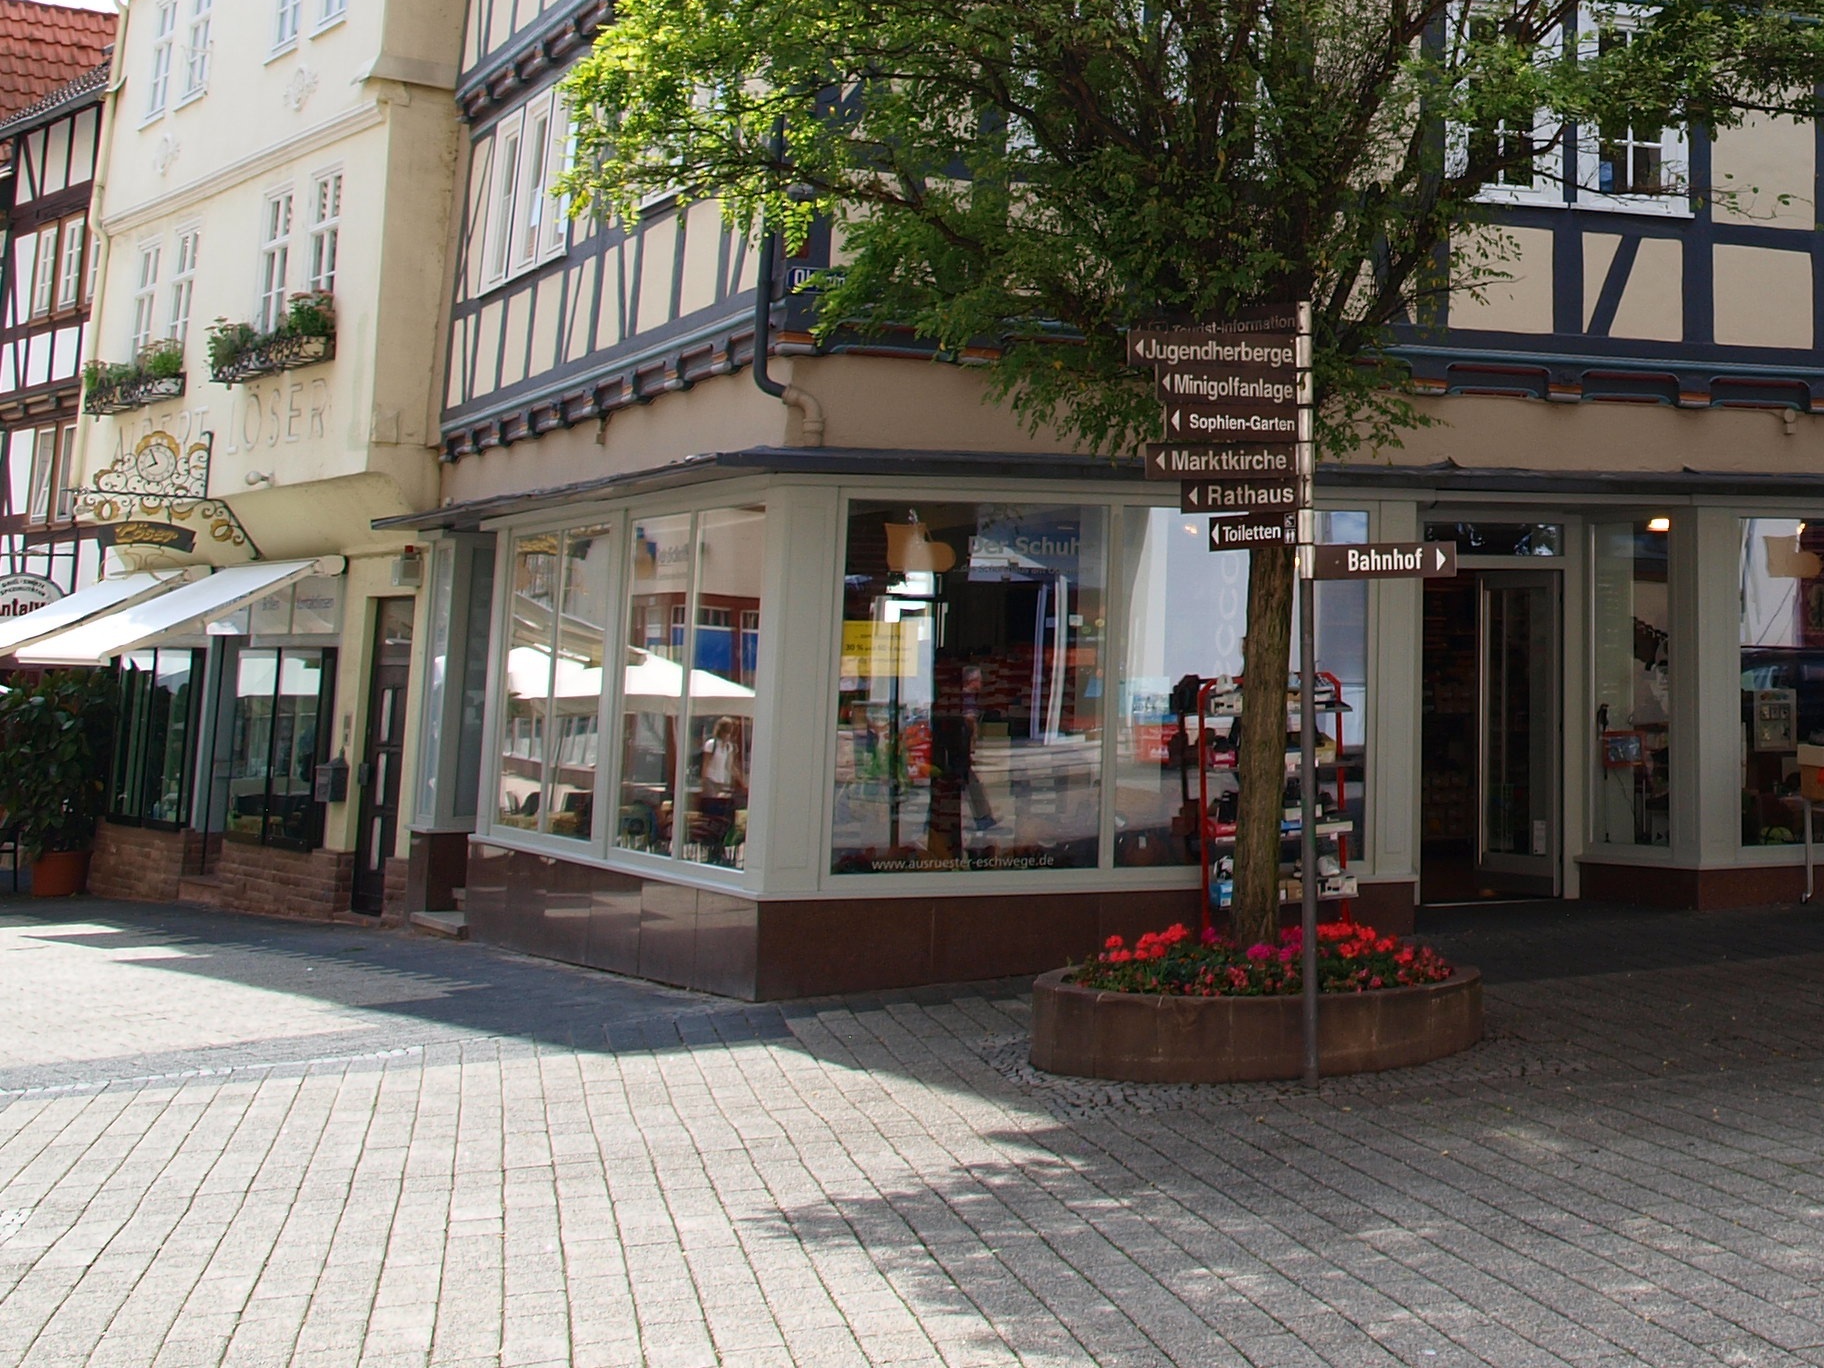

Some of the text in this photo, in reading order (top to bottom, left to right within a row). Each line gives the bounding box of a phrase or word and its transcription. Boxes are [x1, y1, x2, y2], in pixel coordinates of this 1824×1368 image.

[1145, 338, 1293, 367] Jugendherberge
[1174, 373, 1294, 404] Minigolfanlage
[225, 377, 329, 455] LÖSER
[1189, 413, 1295, 433] Sophien-Garten
[1171, 449, 1287, 471] Marktkirche
[1207, 484, 1295, 506] Rathaus
[968, 535, 1008, 555] Der
[1222, 525, 1282, 543] Toiletten
[1347, 547, 1423, 572] Bahnhof
[871, 854, 1055, 871] www.ausruester-eschwege.de
